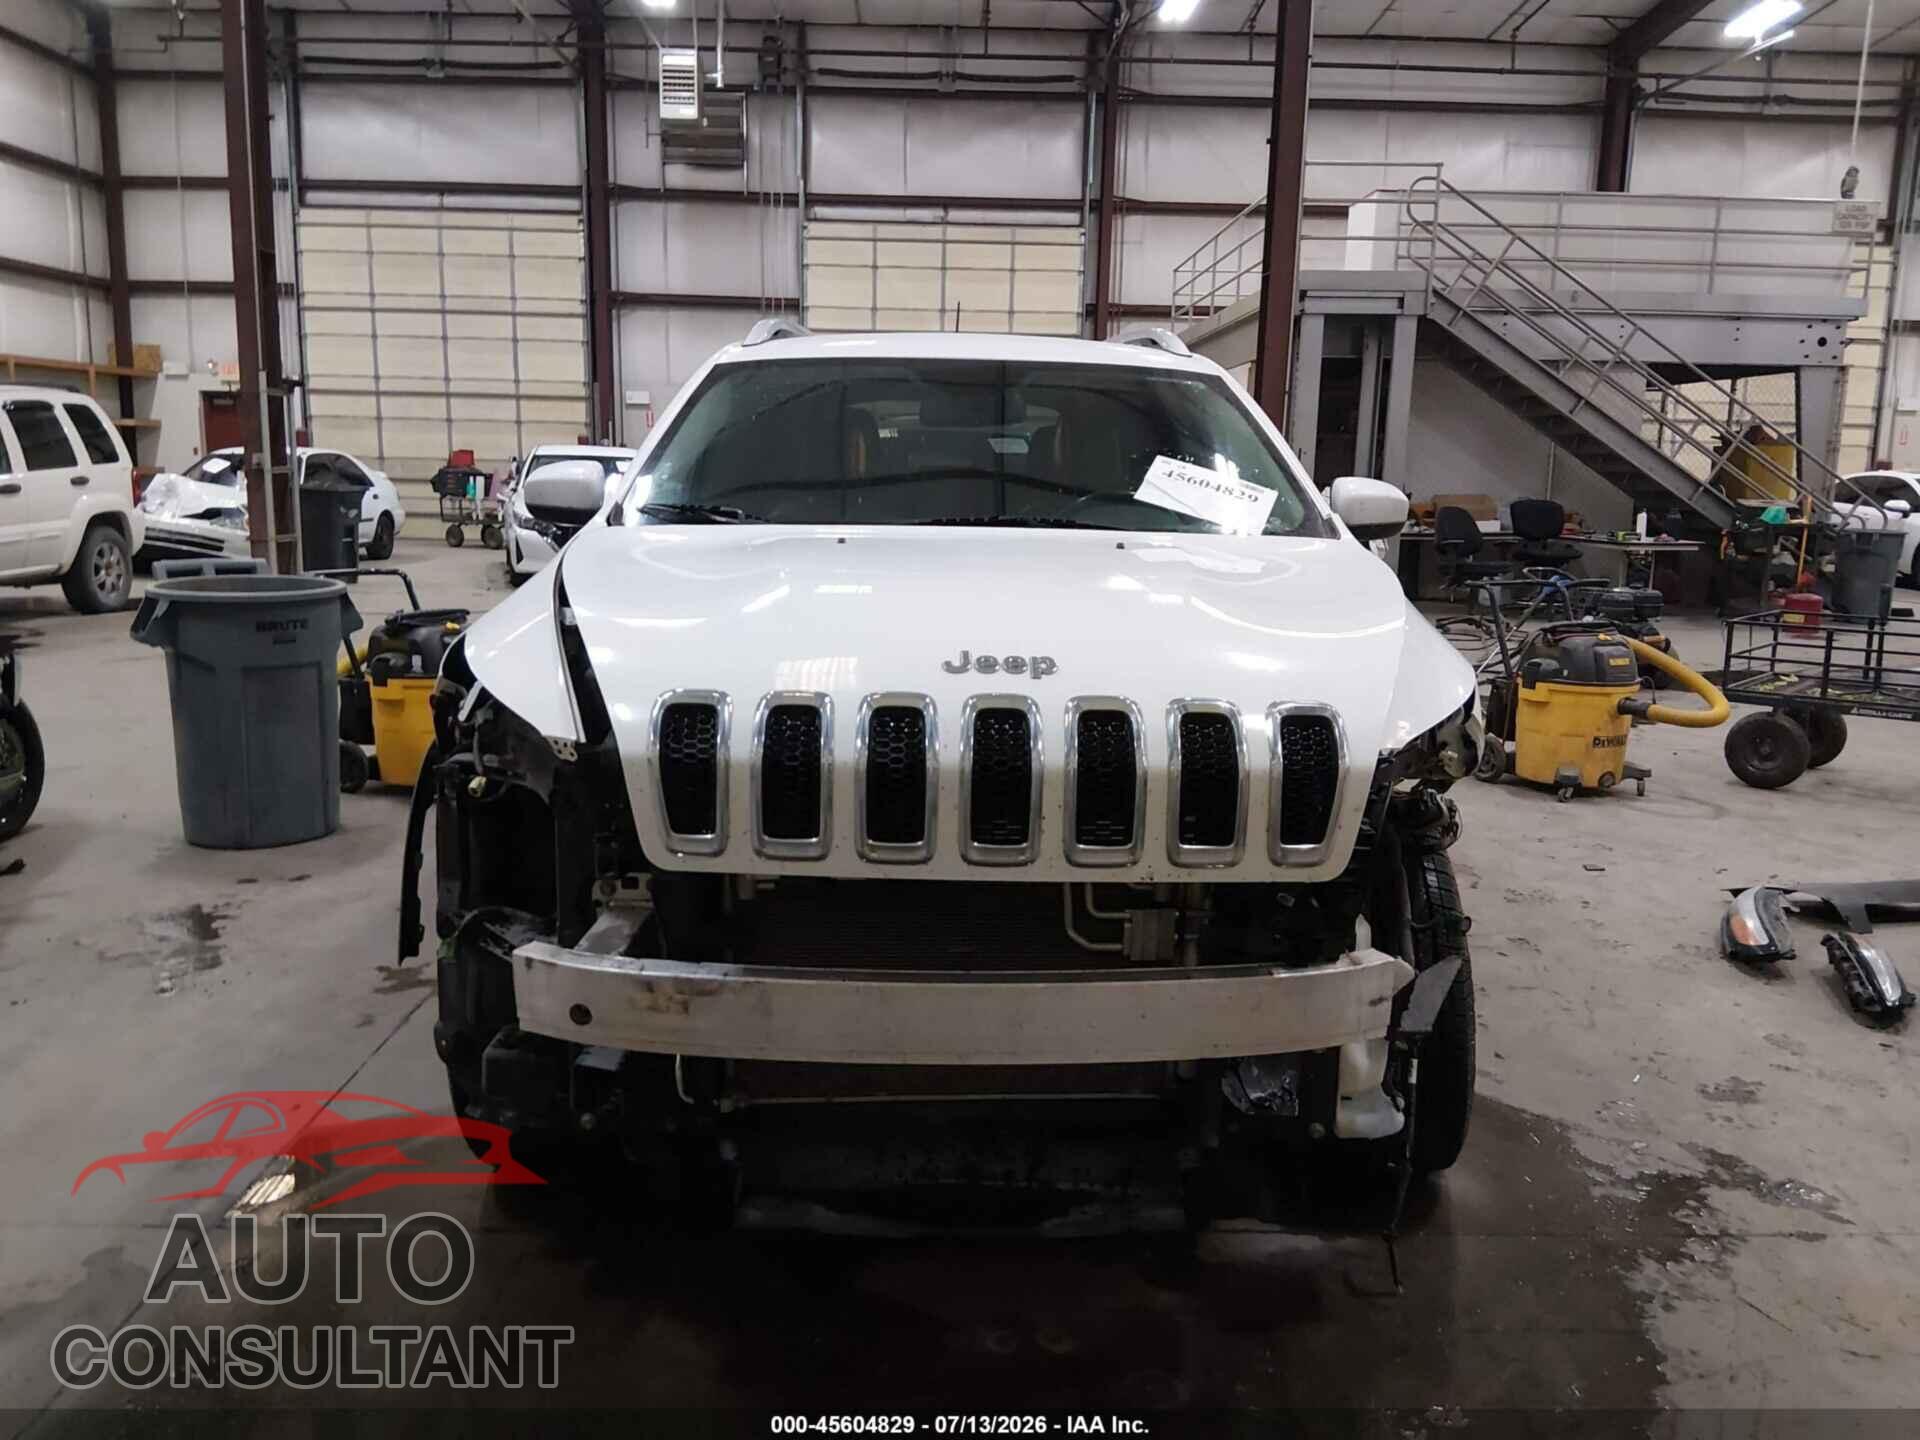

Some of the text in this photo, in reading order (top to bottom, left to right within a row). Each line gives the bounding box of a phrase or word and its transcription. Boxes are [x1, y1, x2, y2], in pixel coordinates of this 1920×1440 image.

[1161, 469, 1260, 504] 45604829
[256, 618, 309, 633] BRUTE
[941, 650, 1059, 680] Jeep
